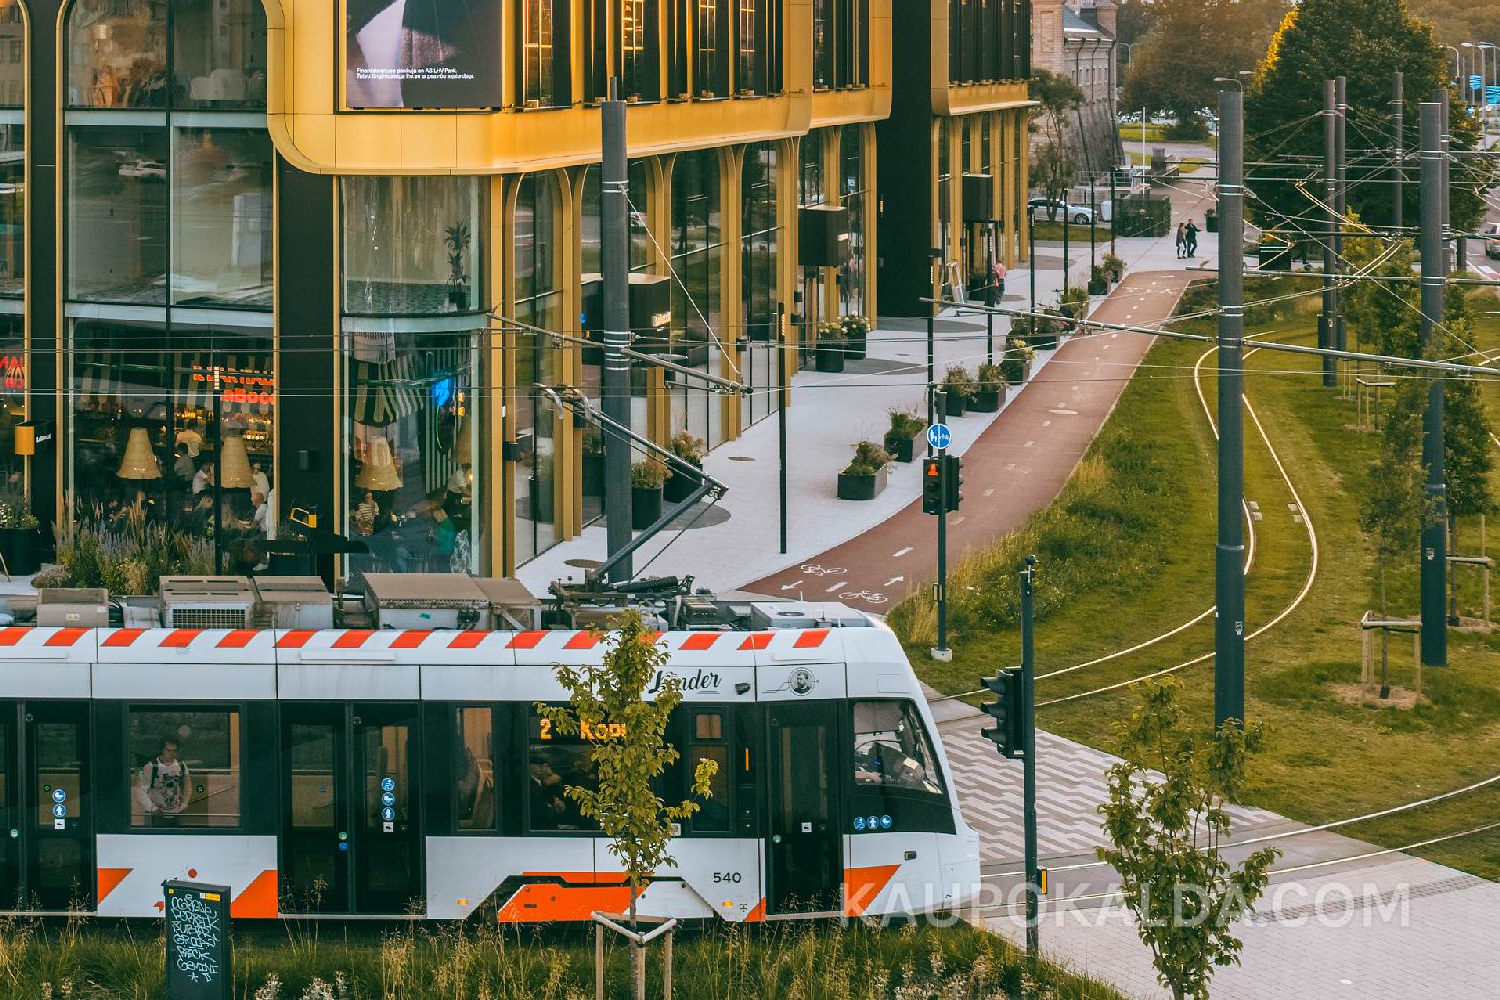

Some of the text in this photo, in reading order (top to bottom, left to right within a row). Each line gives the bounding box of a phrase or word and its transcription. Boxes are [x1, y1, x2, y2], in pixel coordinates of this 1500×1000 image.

[647, 668, 722, 694] Lnder
[539, 718, 553, 740] 2
[712, 871, 743, 884] 540
